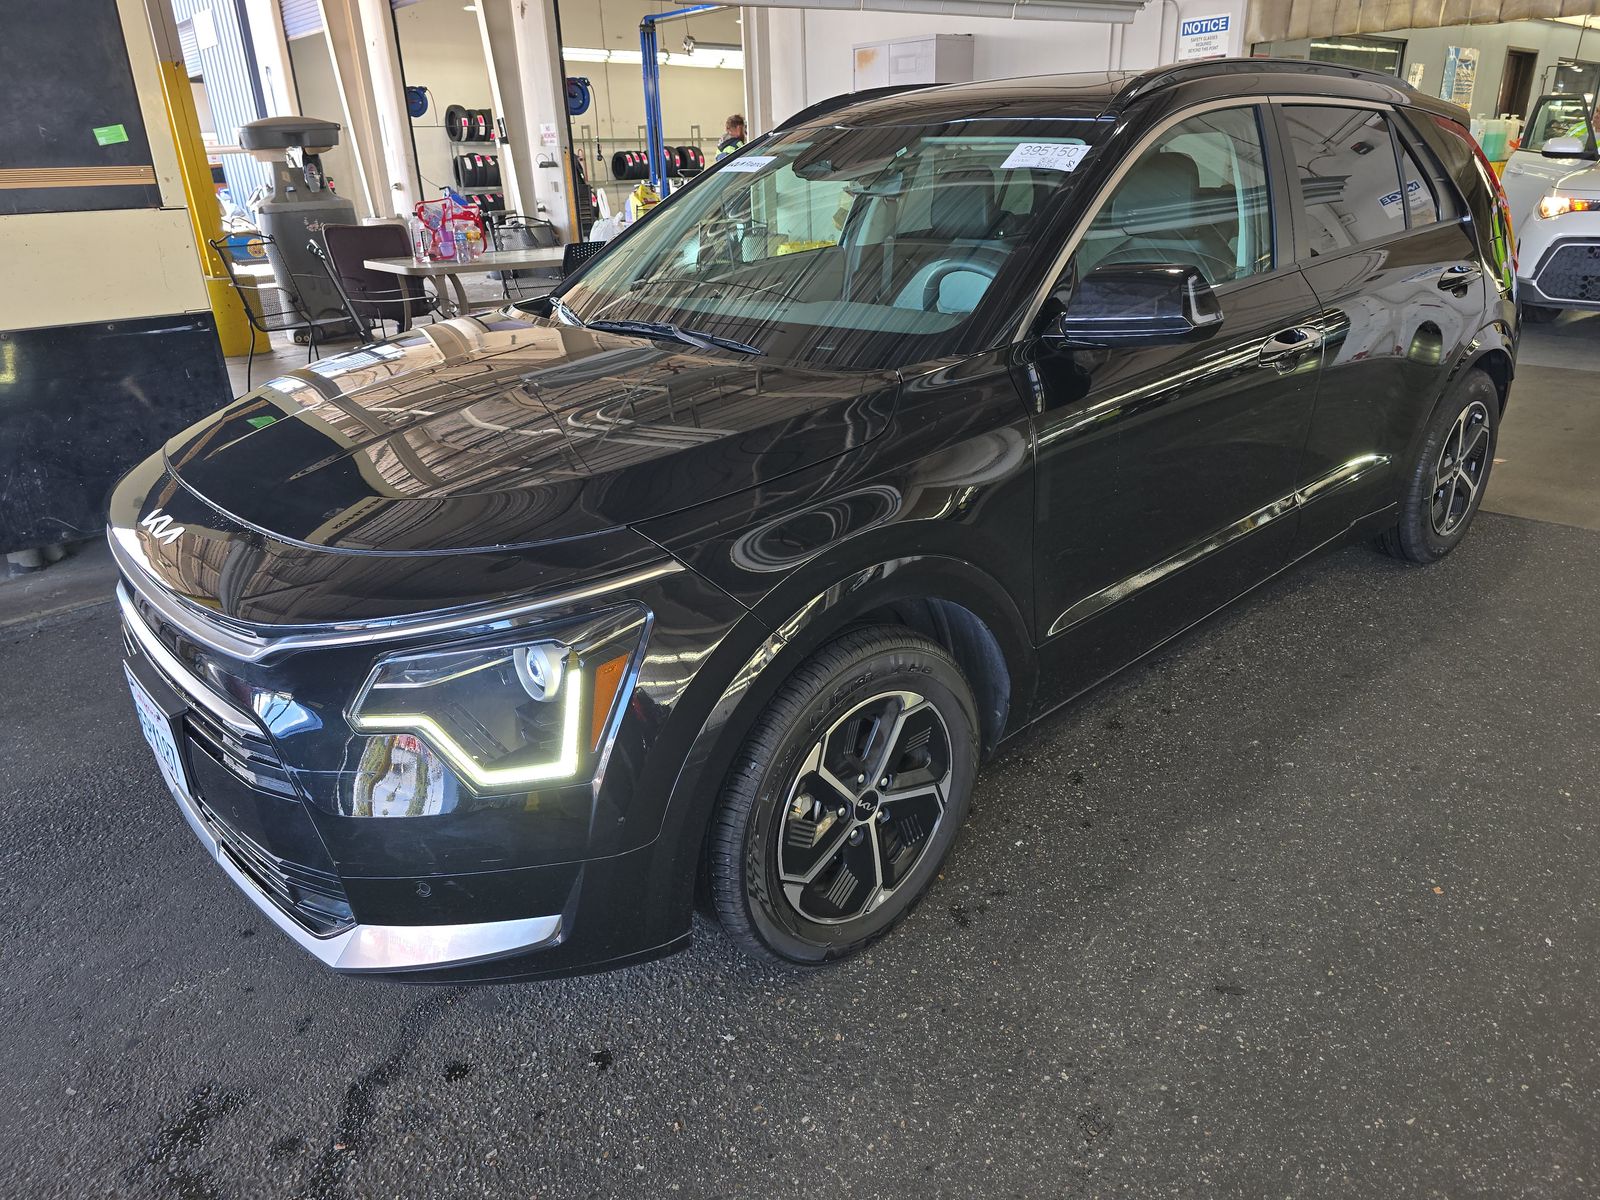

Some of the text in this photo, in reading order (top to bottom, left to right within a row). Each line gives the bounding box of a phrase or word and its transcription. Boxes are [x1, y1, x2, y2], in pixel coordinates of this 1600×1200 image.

[1183, 18, 1227, 35] NOTICE
[1020, 145, 1079, 158] 395150
[141, 507, 187, 545] KIA
